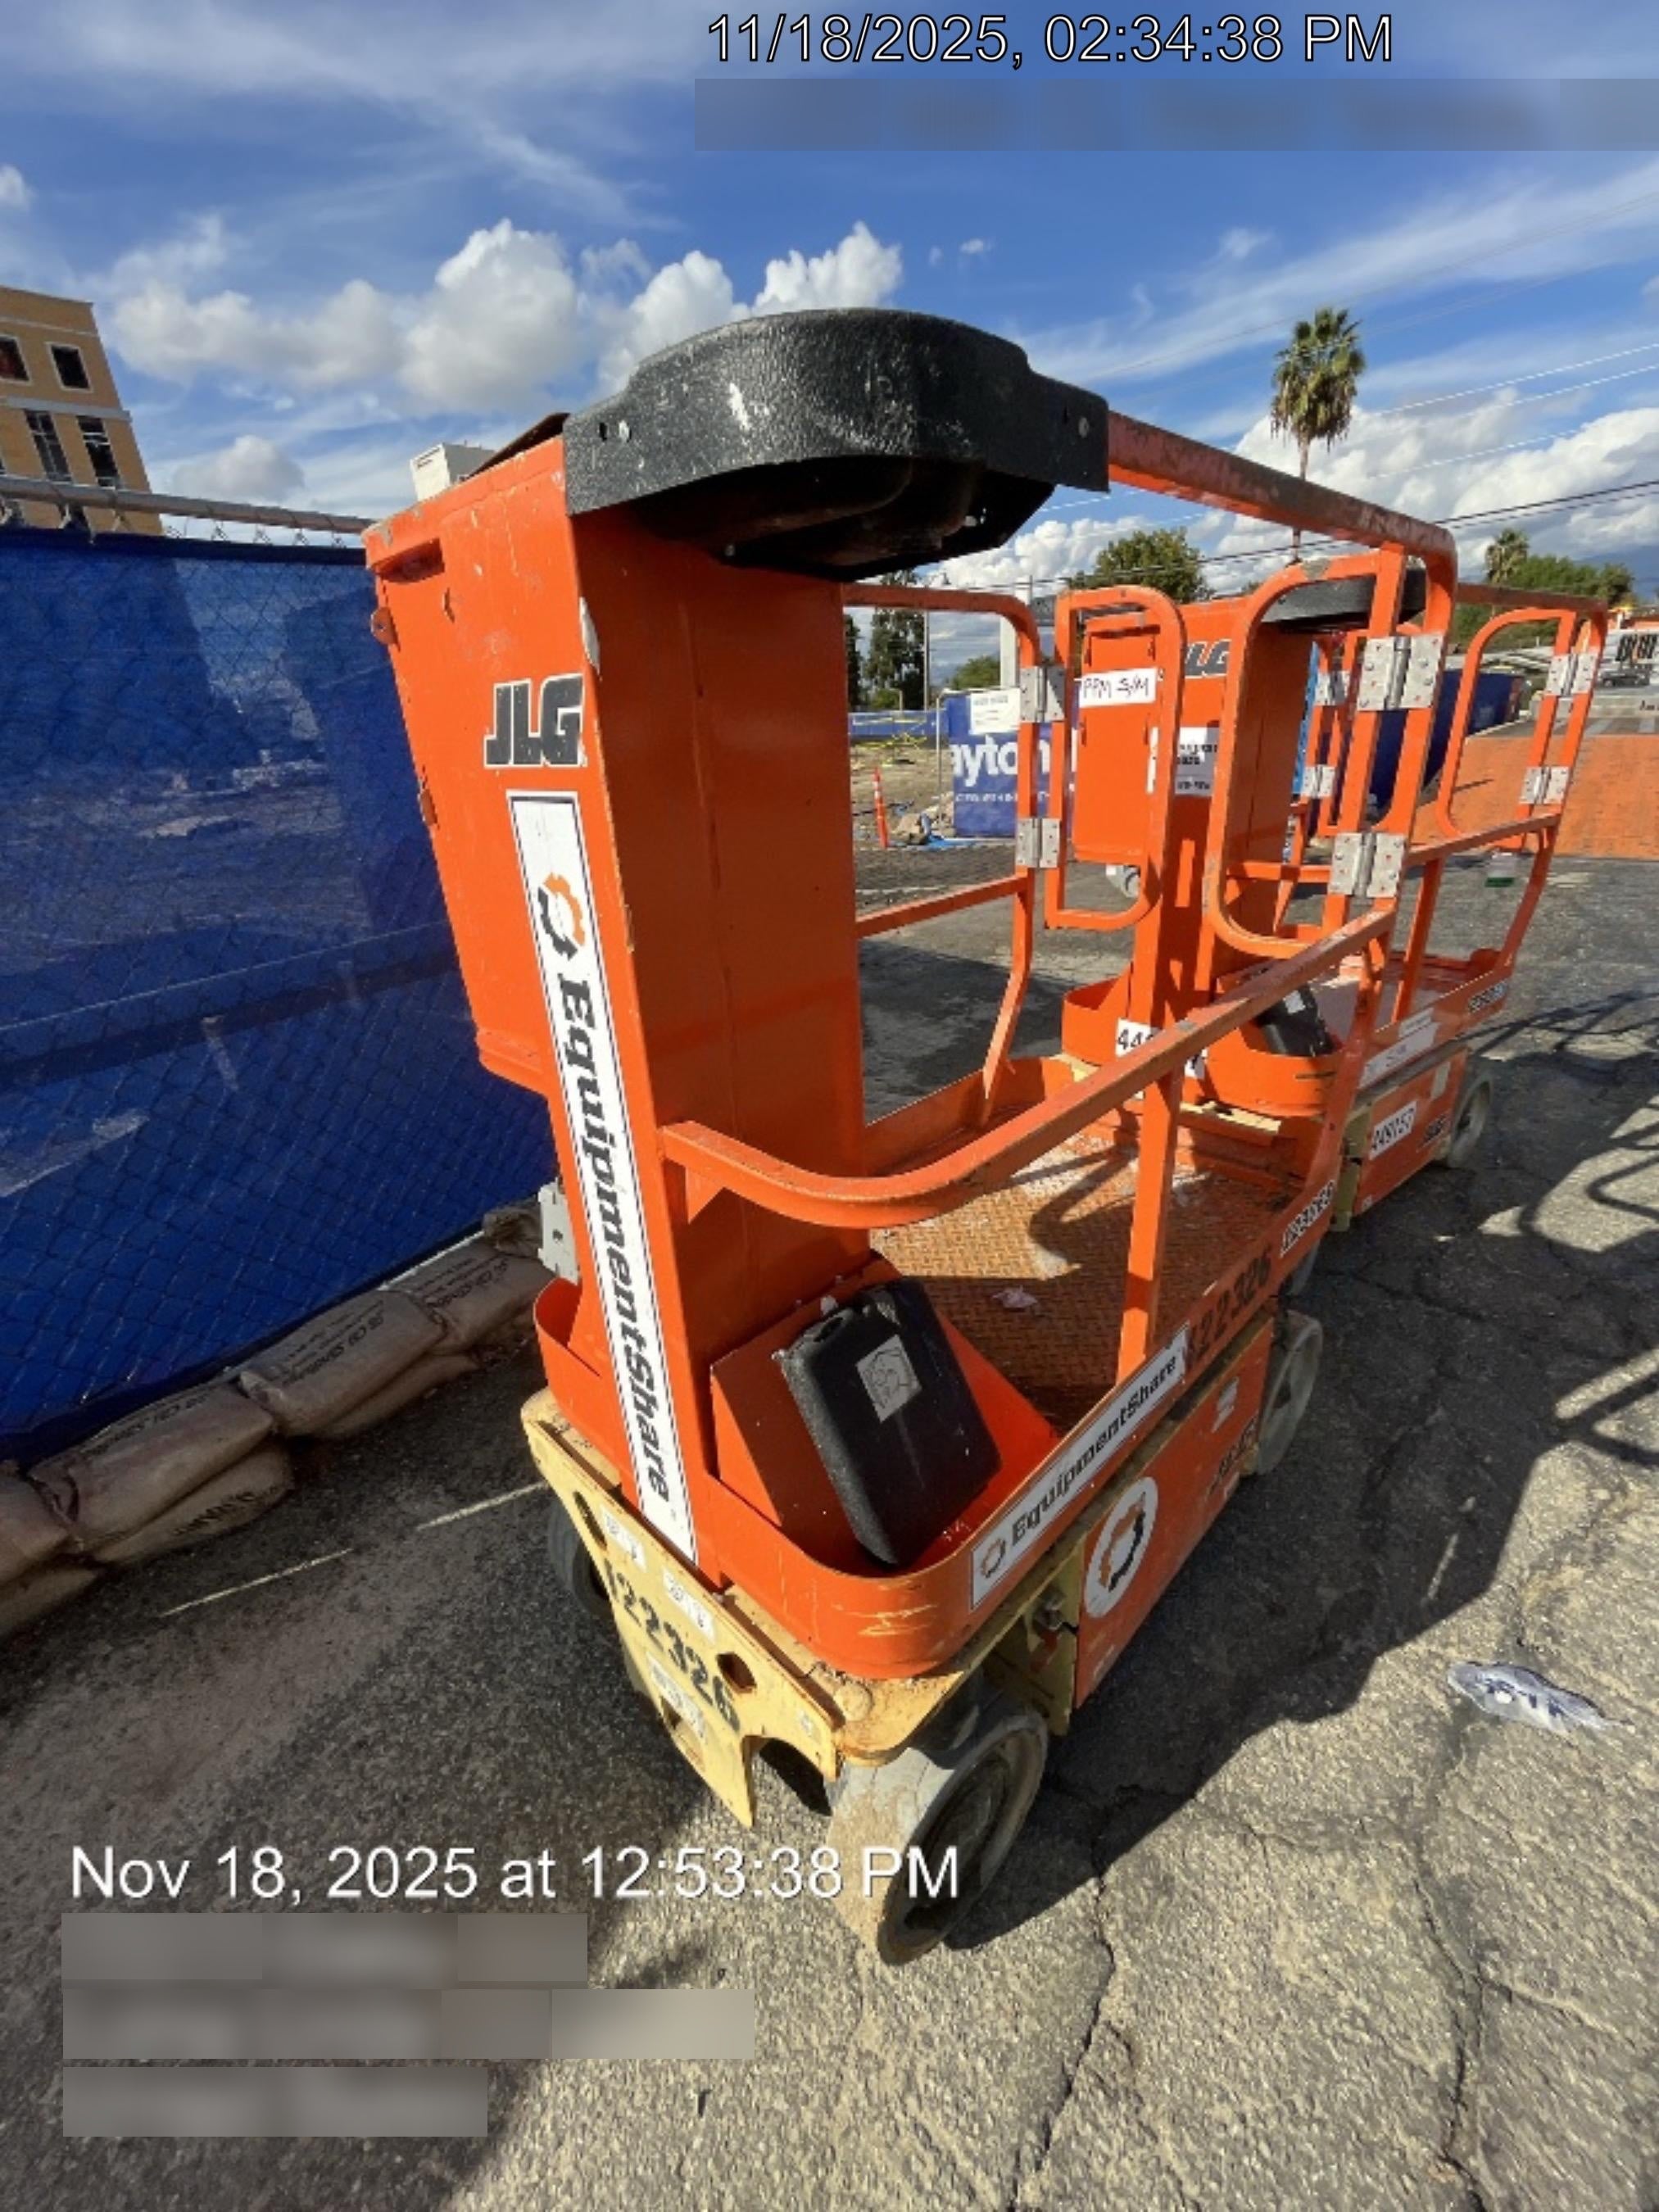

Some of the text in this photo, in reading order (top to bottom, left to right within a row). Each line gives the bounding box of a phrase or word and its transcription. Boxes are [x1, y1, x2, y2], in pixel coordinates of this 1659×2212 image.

[483, 674, 585, 768] JLG
[1185, 638, 1231, 679] LG
[557, 972, 670, 1504] EquipmentShare
[1012, 1355, 1176, 1547] EquipmentShare
[604, 1558, 740, 1732] 122326
